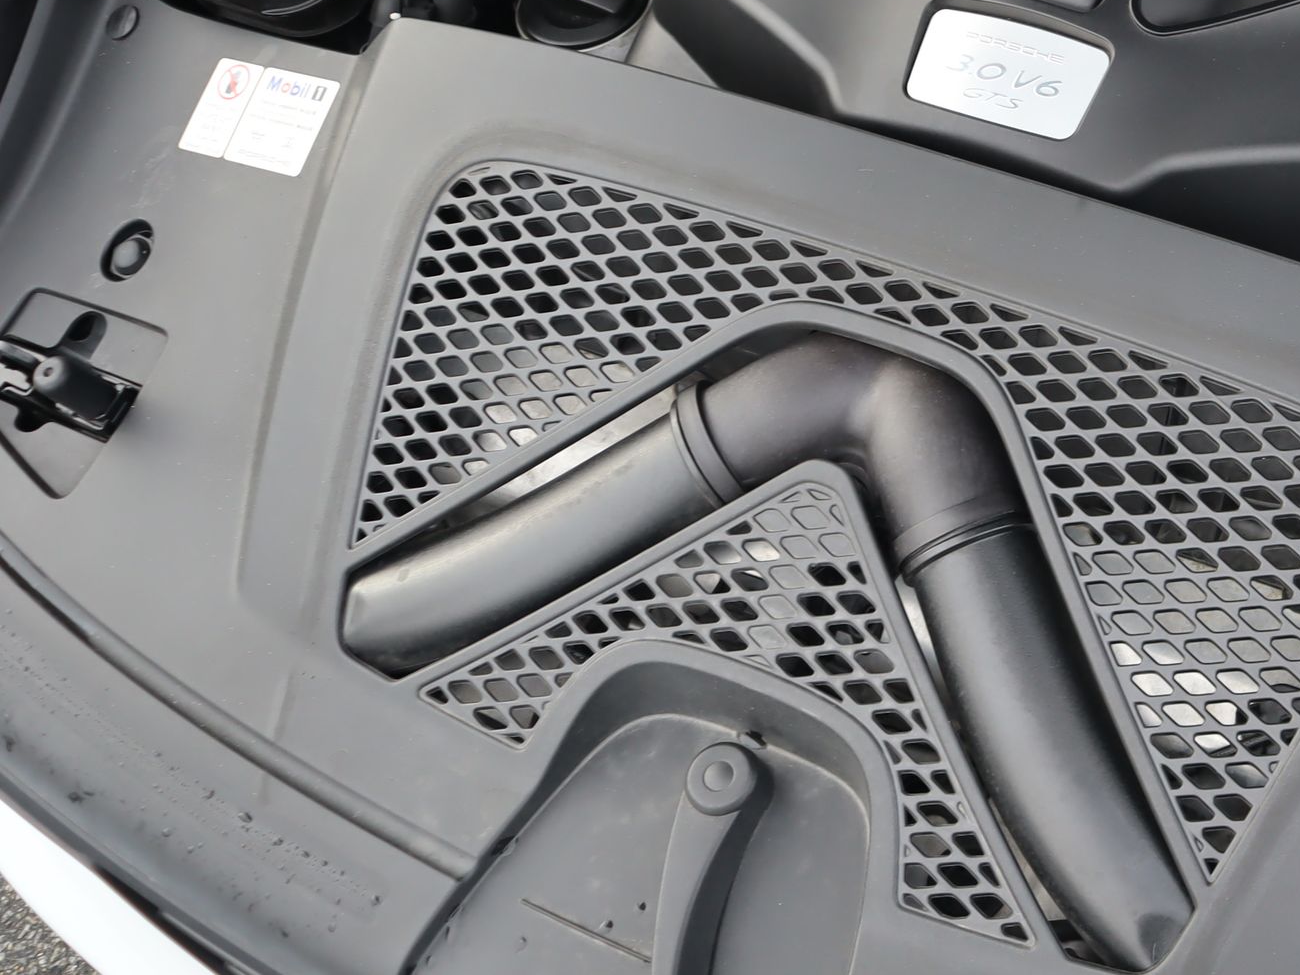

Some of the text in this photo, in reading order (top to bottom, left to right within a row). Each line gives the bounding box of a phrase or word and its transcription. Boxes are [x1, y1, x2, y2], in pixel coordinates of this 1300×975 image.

[965, 31, 1065, 65] PORSCHE
[266, 75, 312, 98] Mobil
[1013, 70, 1063, 98] V6
[962, 87, 1024, 110] GTS
